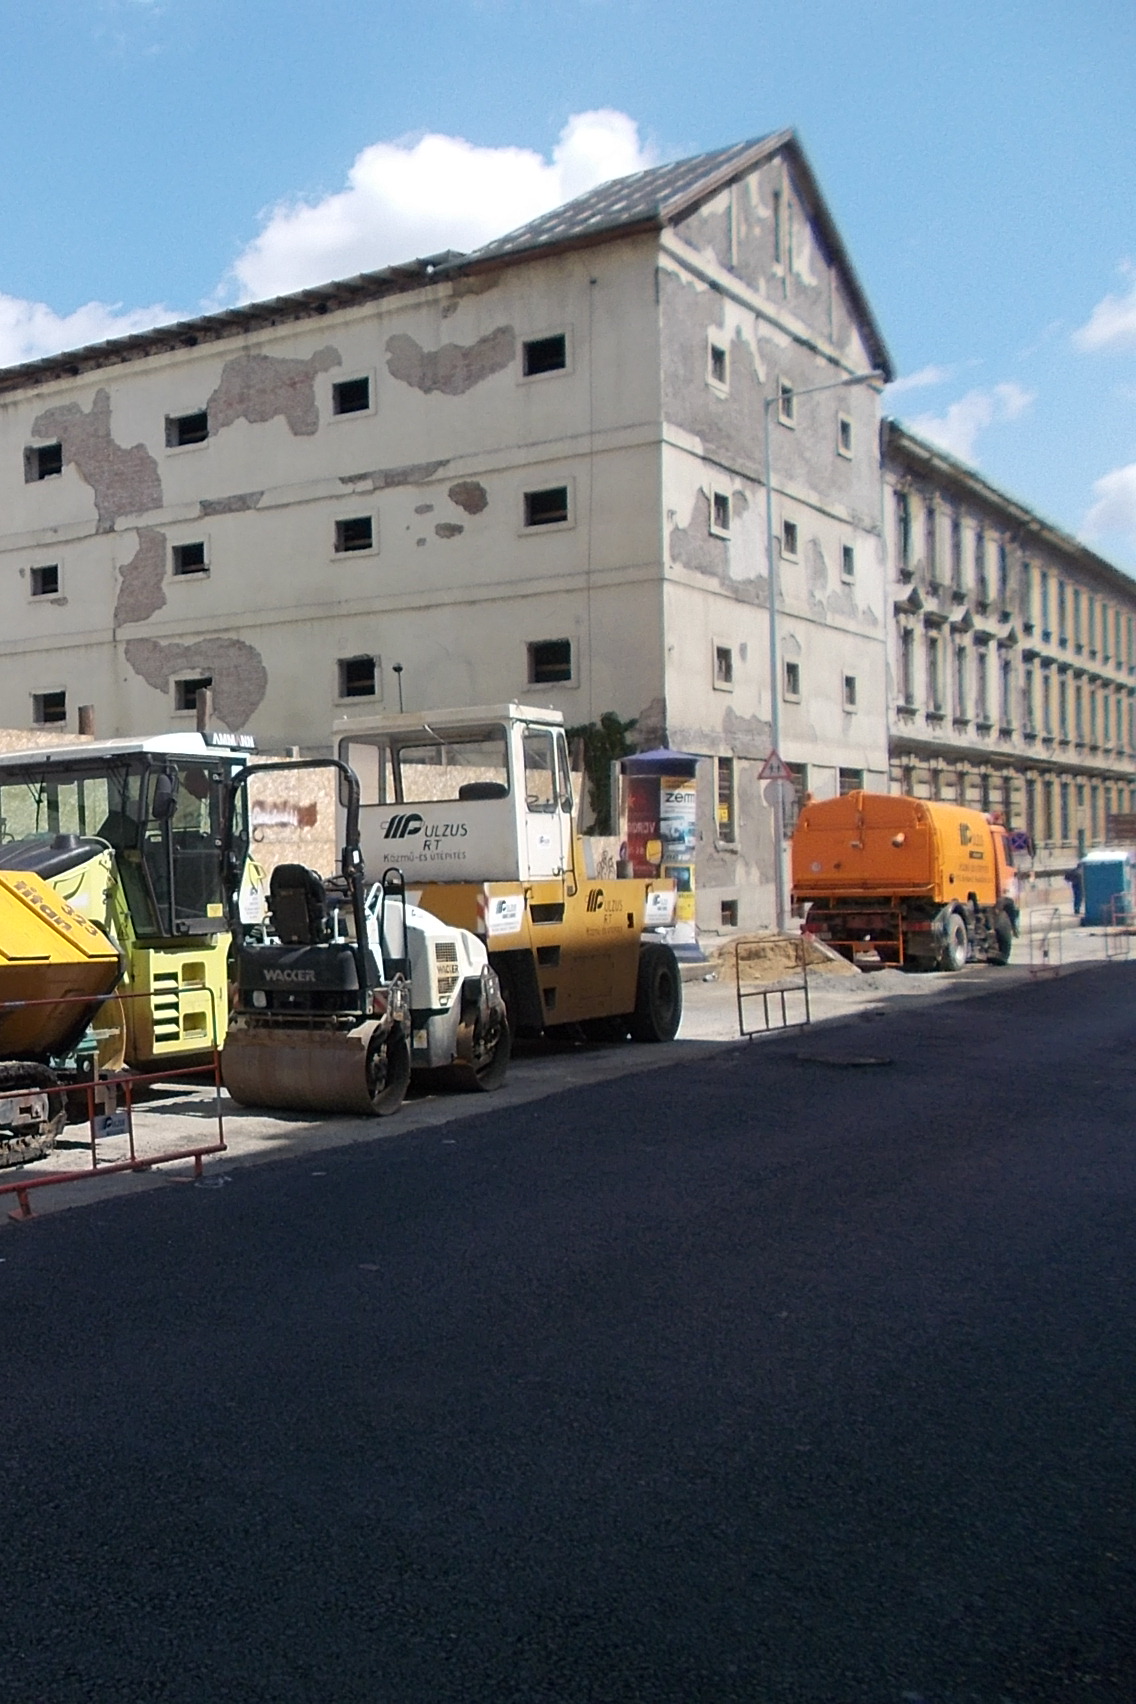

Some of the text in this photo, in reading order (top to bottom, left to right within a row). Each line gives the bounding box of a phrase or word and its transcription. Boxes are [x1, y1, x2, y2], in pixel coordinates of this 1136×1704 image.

[213, 732, 255, 748] AMMANN
[423, 840, 442, 851] RT
[61, 904, 99, 936] 323
[263, 969, 316, 982] WACKER
